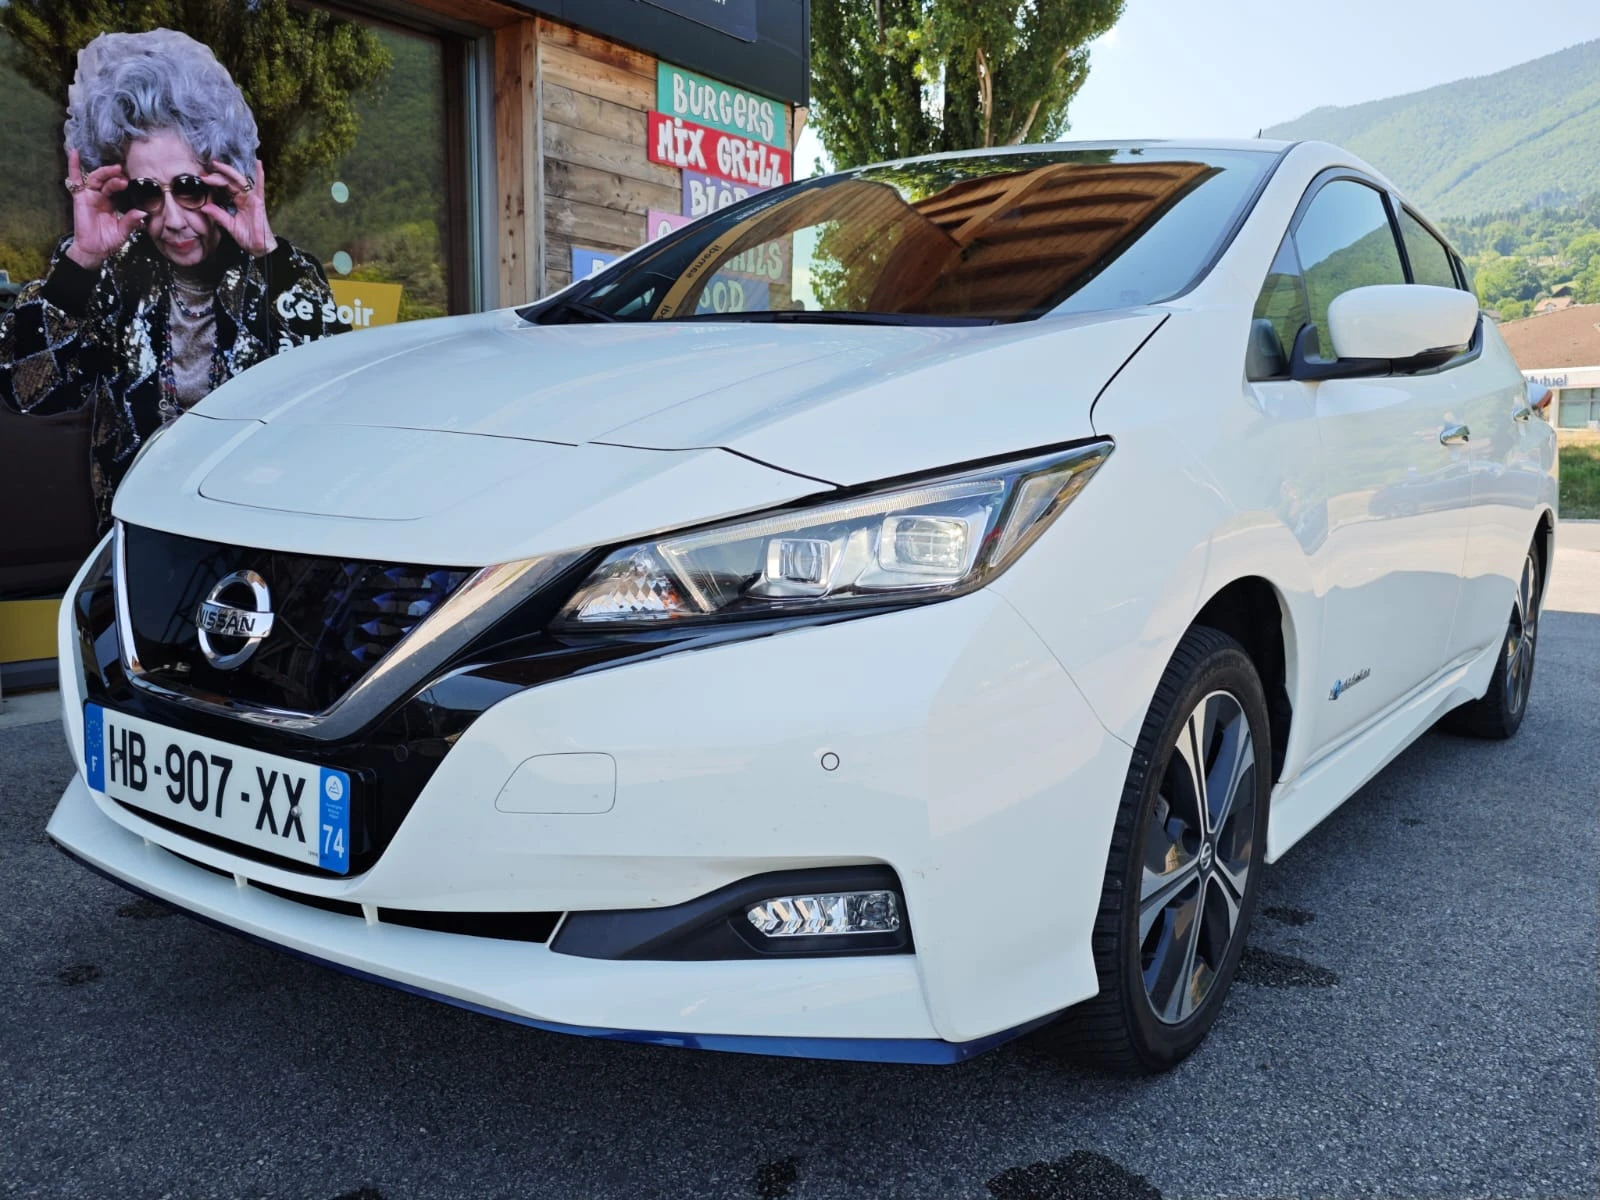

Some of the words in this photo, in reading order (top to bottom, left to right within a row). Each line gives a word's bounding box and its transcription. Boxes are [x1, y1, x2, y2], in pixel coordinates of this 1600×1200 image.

[717, 136, 784, 189] GRILL
[276, 292, 314, 321] Ce
[321, 298, 374, 327] soir
[196, 606, 256, 632] NISSAN
[91, 755, 98, 773] F
[109, 724, 306, 843] HB-907-XX
[322, 824, 345, 859] 74
